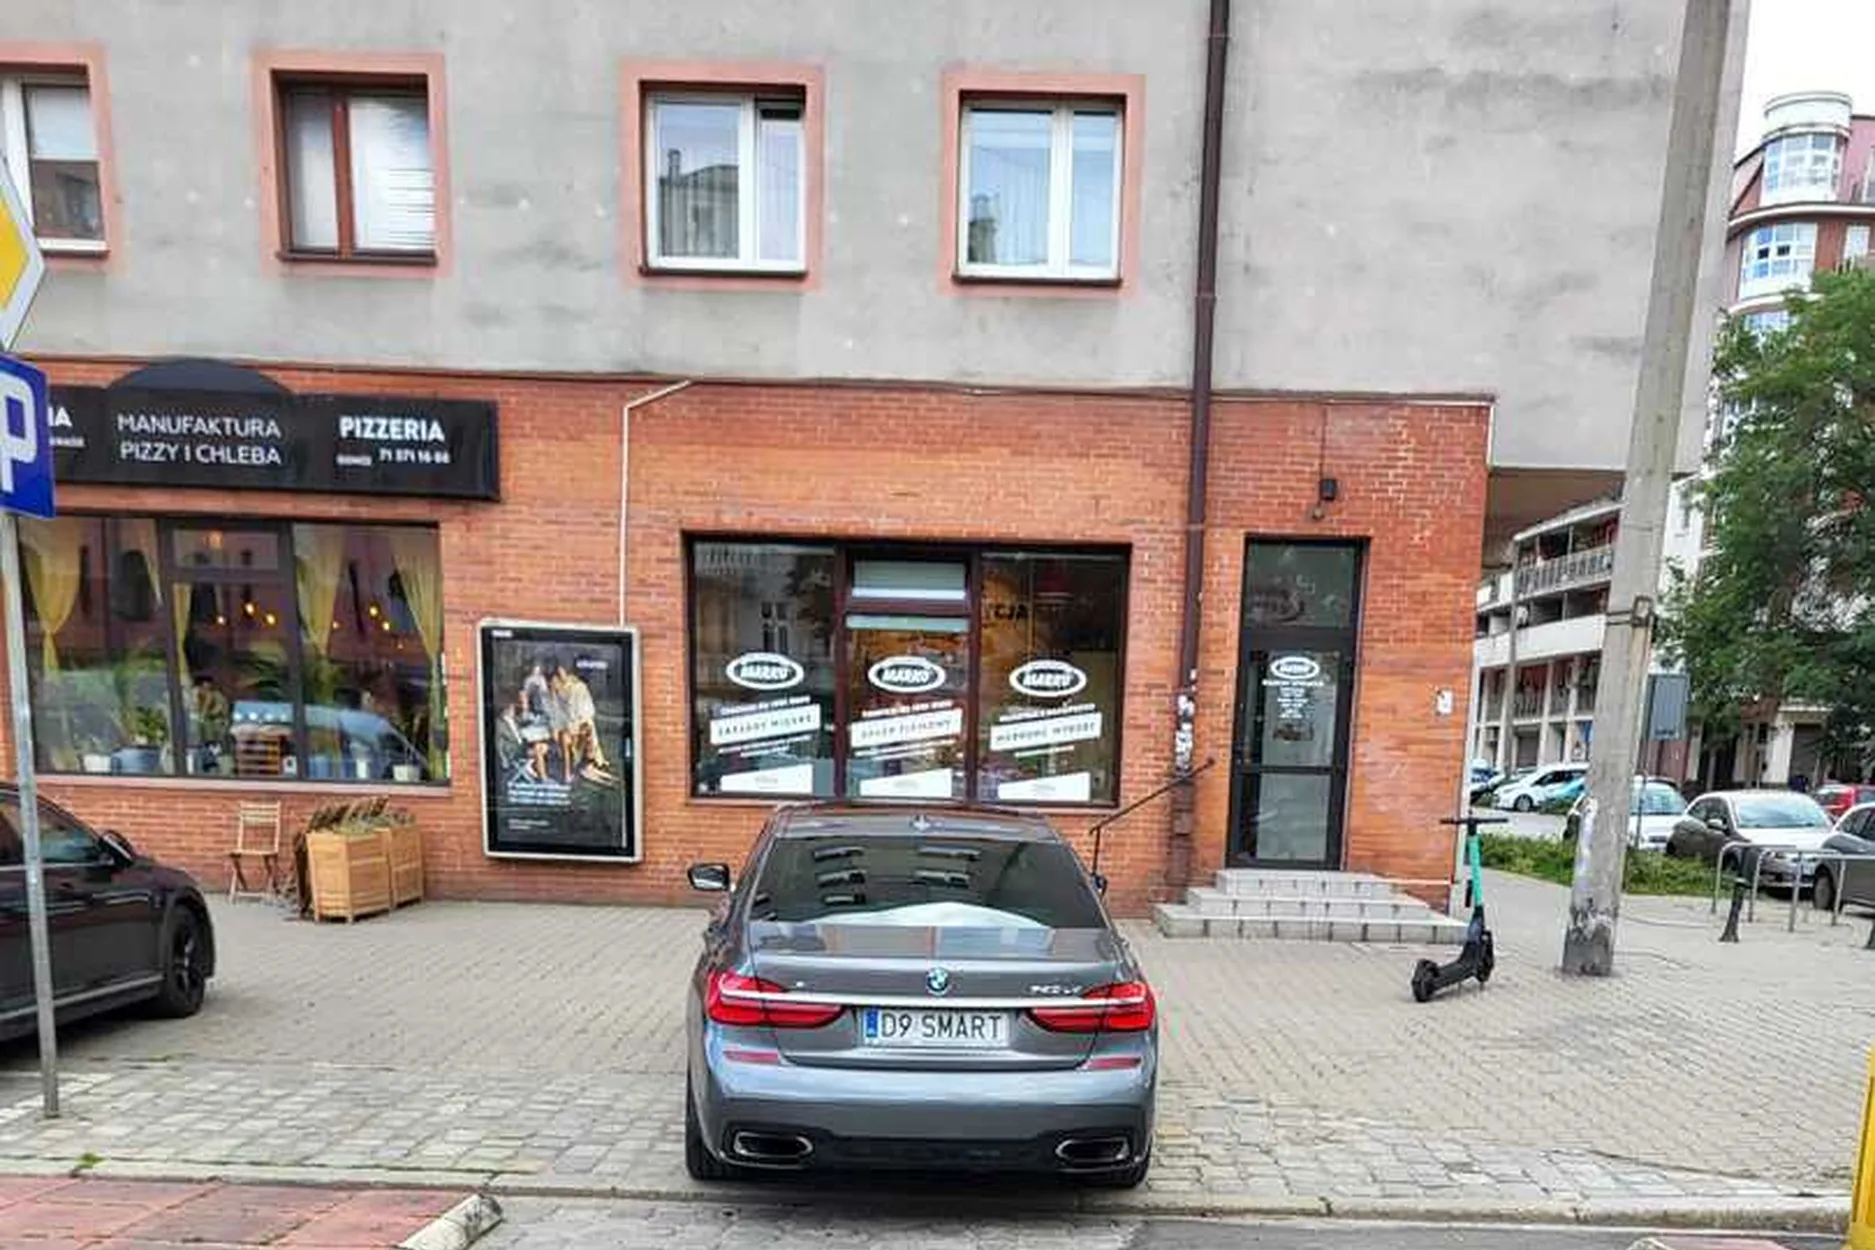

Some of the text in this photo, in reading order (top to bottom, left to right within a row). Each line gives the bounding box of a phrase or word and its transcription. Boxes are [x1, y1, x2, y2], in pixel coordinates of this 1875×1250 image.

[0, 371, 38, 494] P
[117, 413, 282, 438] MANUFAKTURA
[339, 414, 446, 442] PIZZERIA
[120, 441, 282, 465] PIZZY I CHLEBA
[881, 1013, 1003, 1039] D9 SMART
